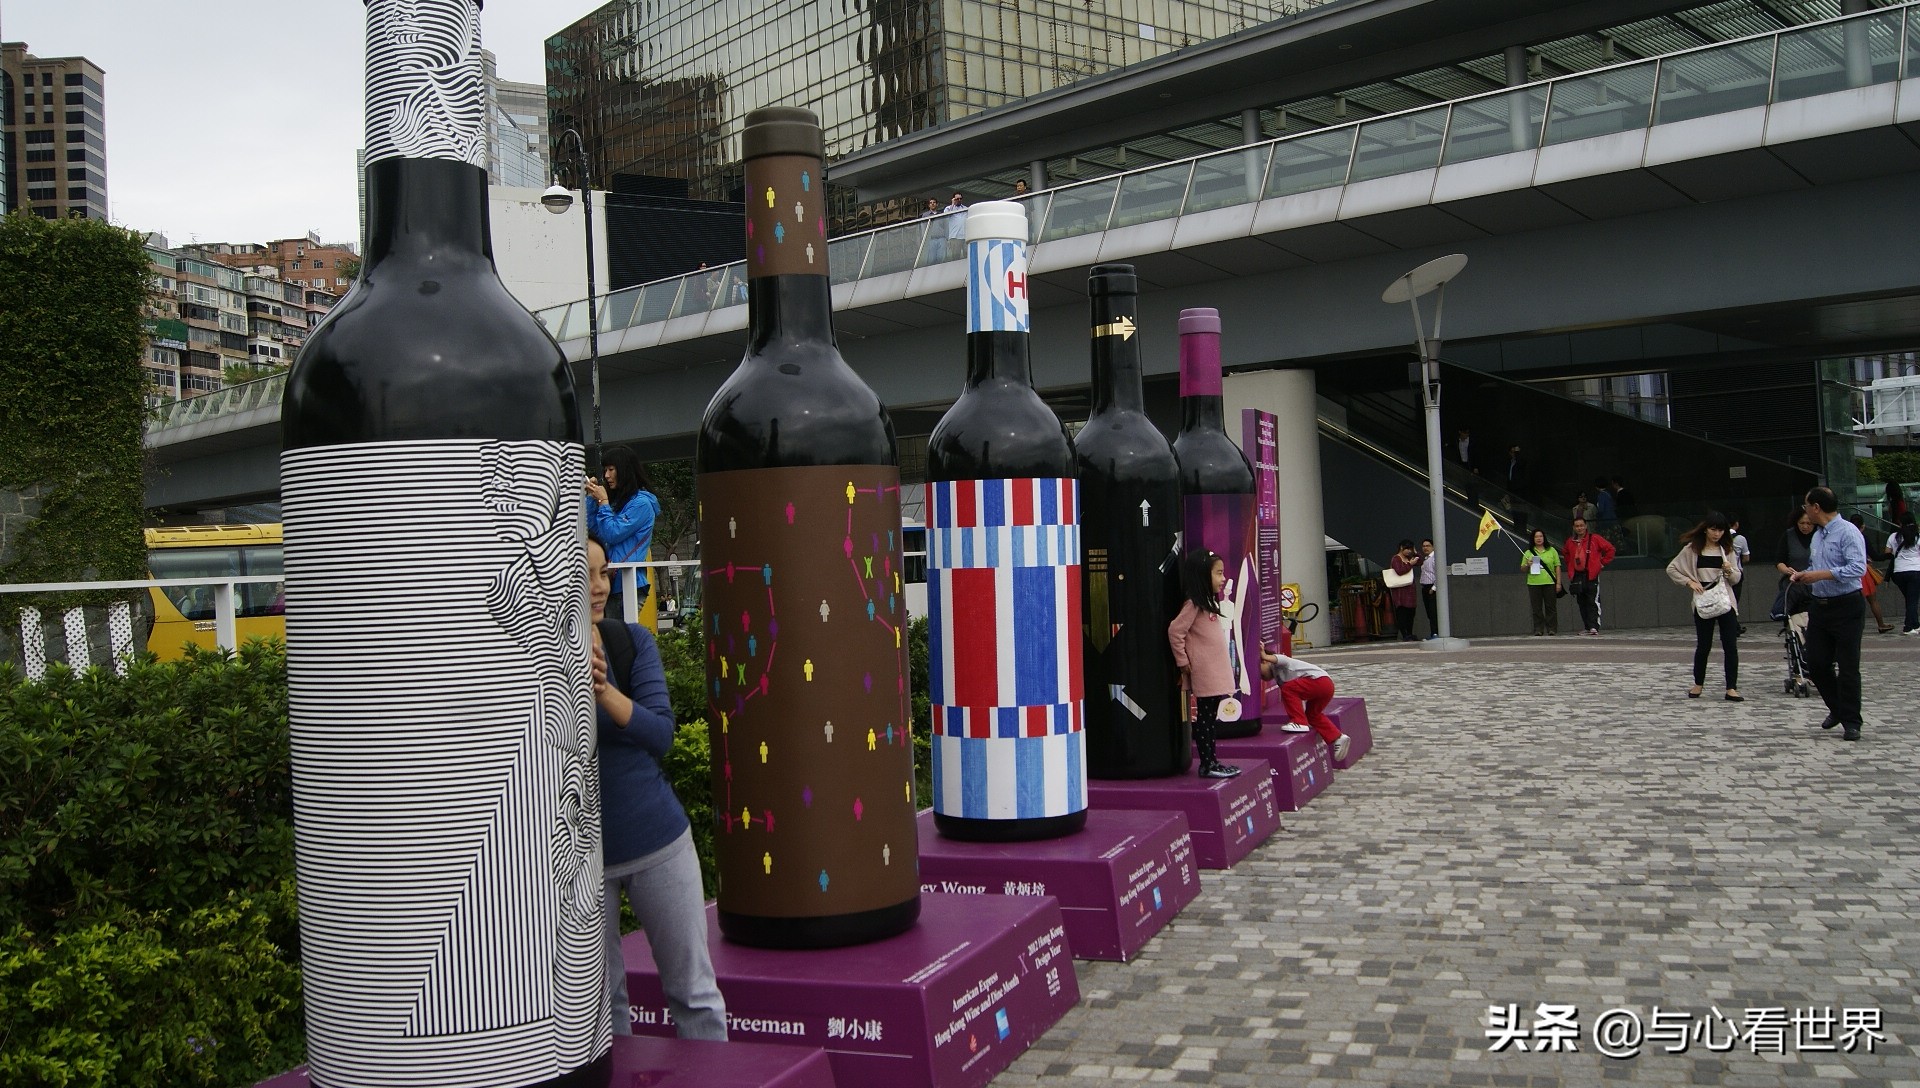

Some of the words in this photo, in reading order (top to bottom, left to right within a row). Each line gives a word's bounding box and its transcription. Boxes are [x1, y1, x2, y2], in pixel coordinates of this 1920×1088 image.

[1050, 925, 1064, 940] Kong
[1034, 952, 1051, 970] Design
[1050, 944, 1062, 958] Year
[952, 986, 980, 1012] American
[978, 972, 998, 993] Express
[629, 1005, 656, 1024] Siu
[934, 1028, 952, 1048] Hong
[950, 1016, 966, 1036] Kong
[964, 1006, 981, 1022] Wine
[980, 994, 992, 1012] and
[990, 988, 1004, 1004] Dine
[1002, 973, 1020, 994] Month
[827, 1016, 883, 1042] 劉小康
